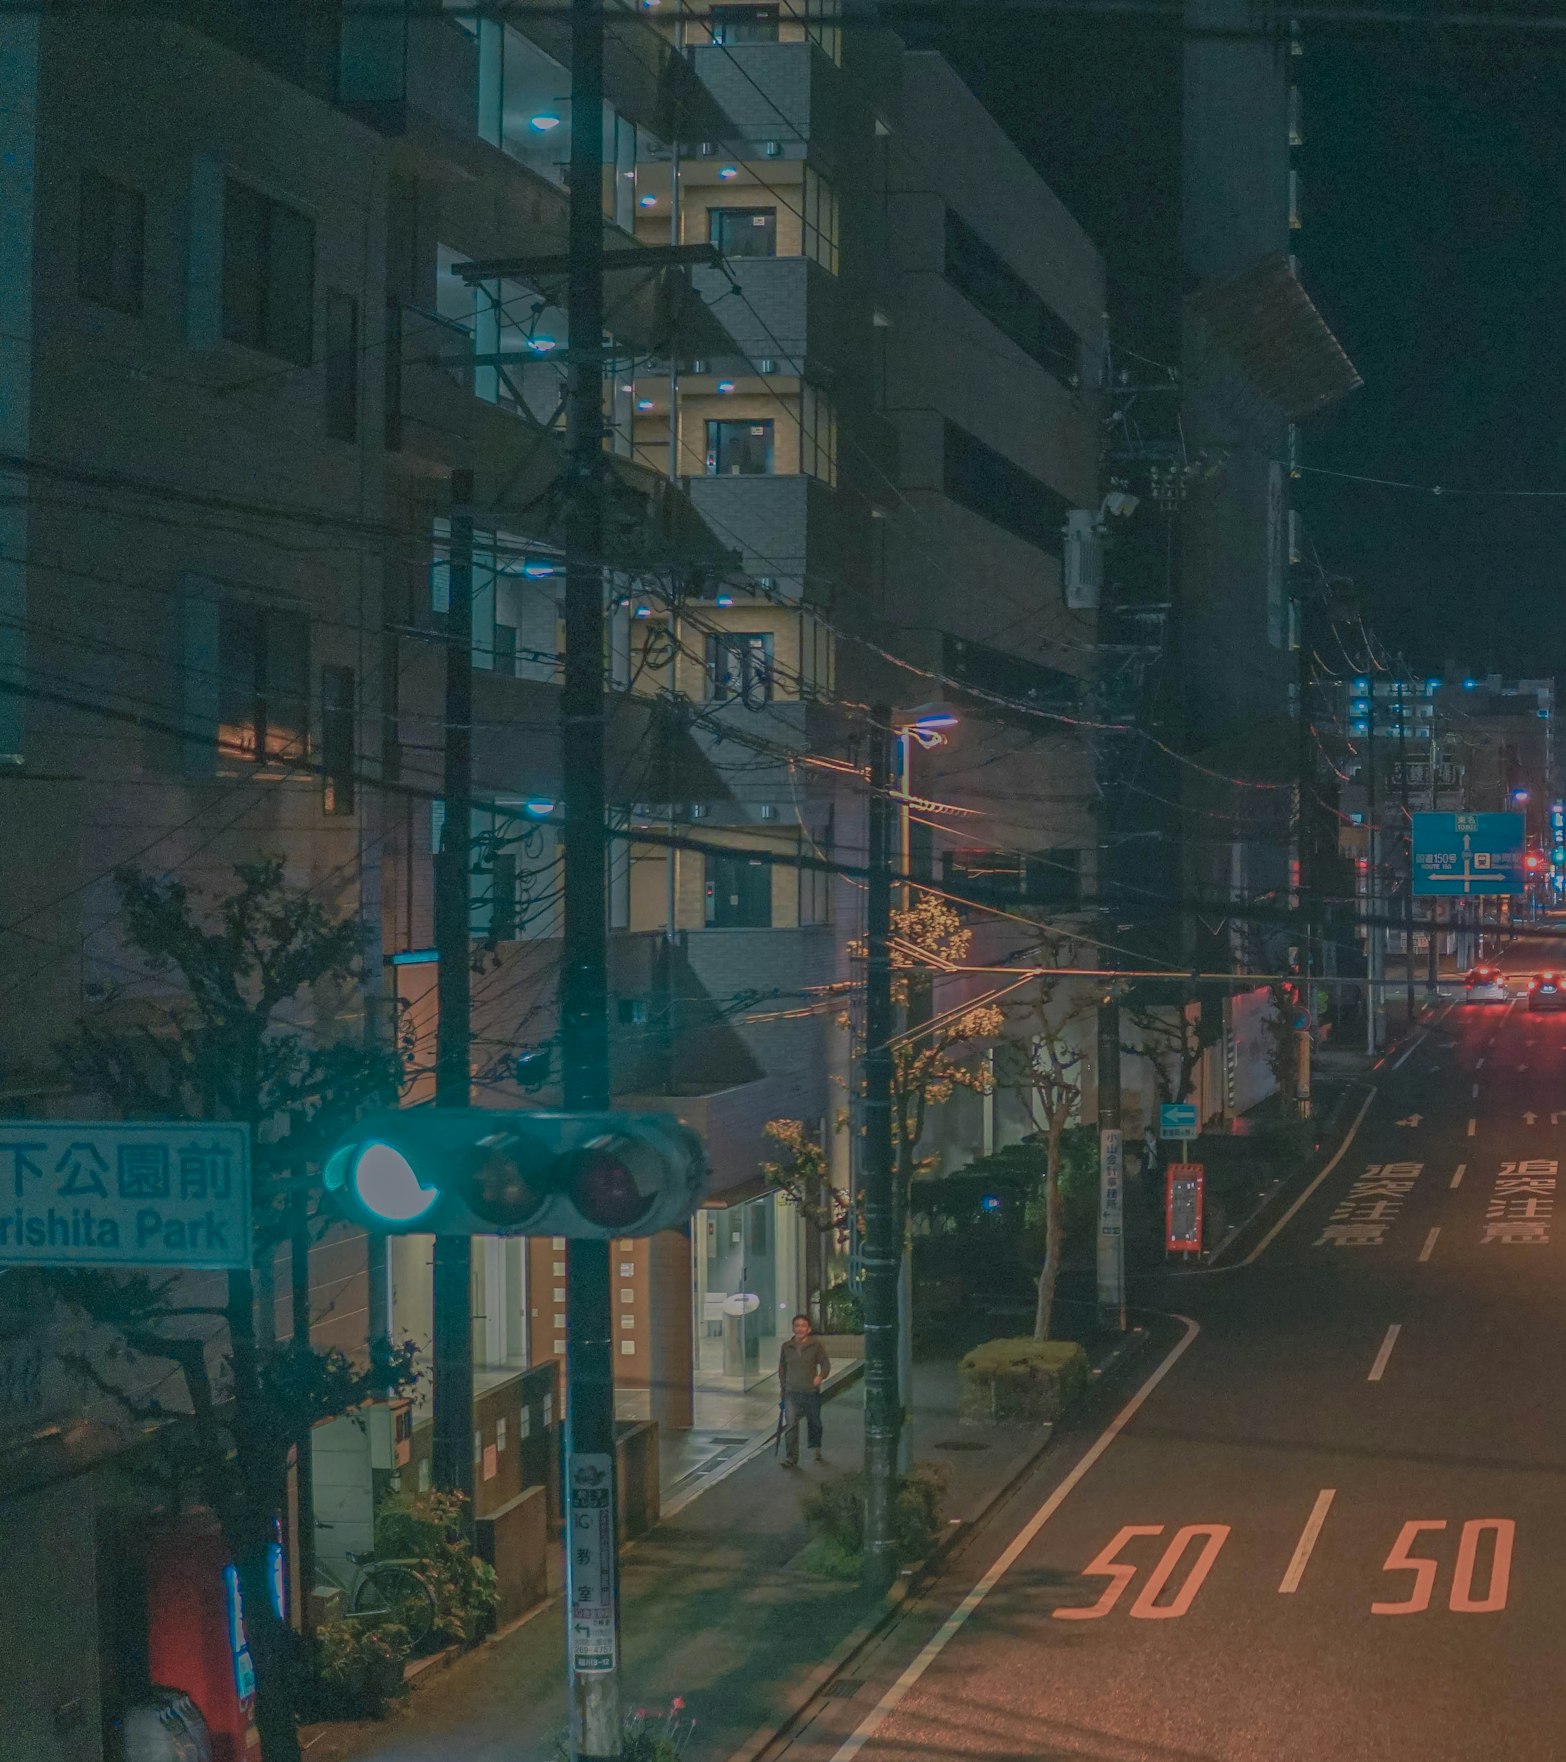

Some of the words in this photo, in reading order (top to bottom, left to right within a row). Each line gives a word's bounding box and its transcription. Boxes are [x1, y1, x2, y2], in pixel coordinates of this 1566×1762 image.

[0, 1142, 233, 1200] 下公園前
[1312, 1162, 1425, 1246] 追突注意
[1479, 1159, 1559, 1244] 追突注意
[137, 1208, 228, 1249] Park
[1052, 1523, 1232, 1620] 50
[1370, 1518, 1516, 1616] 50
